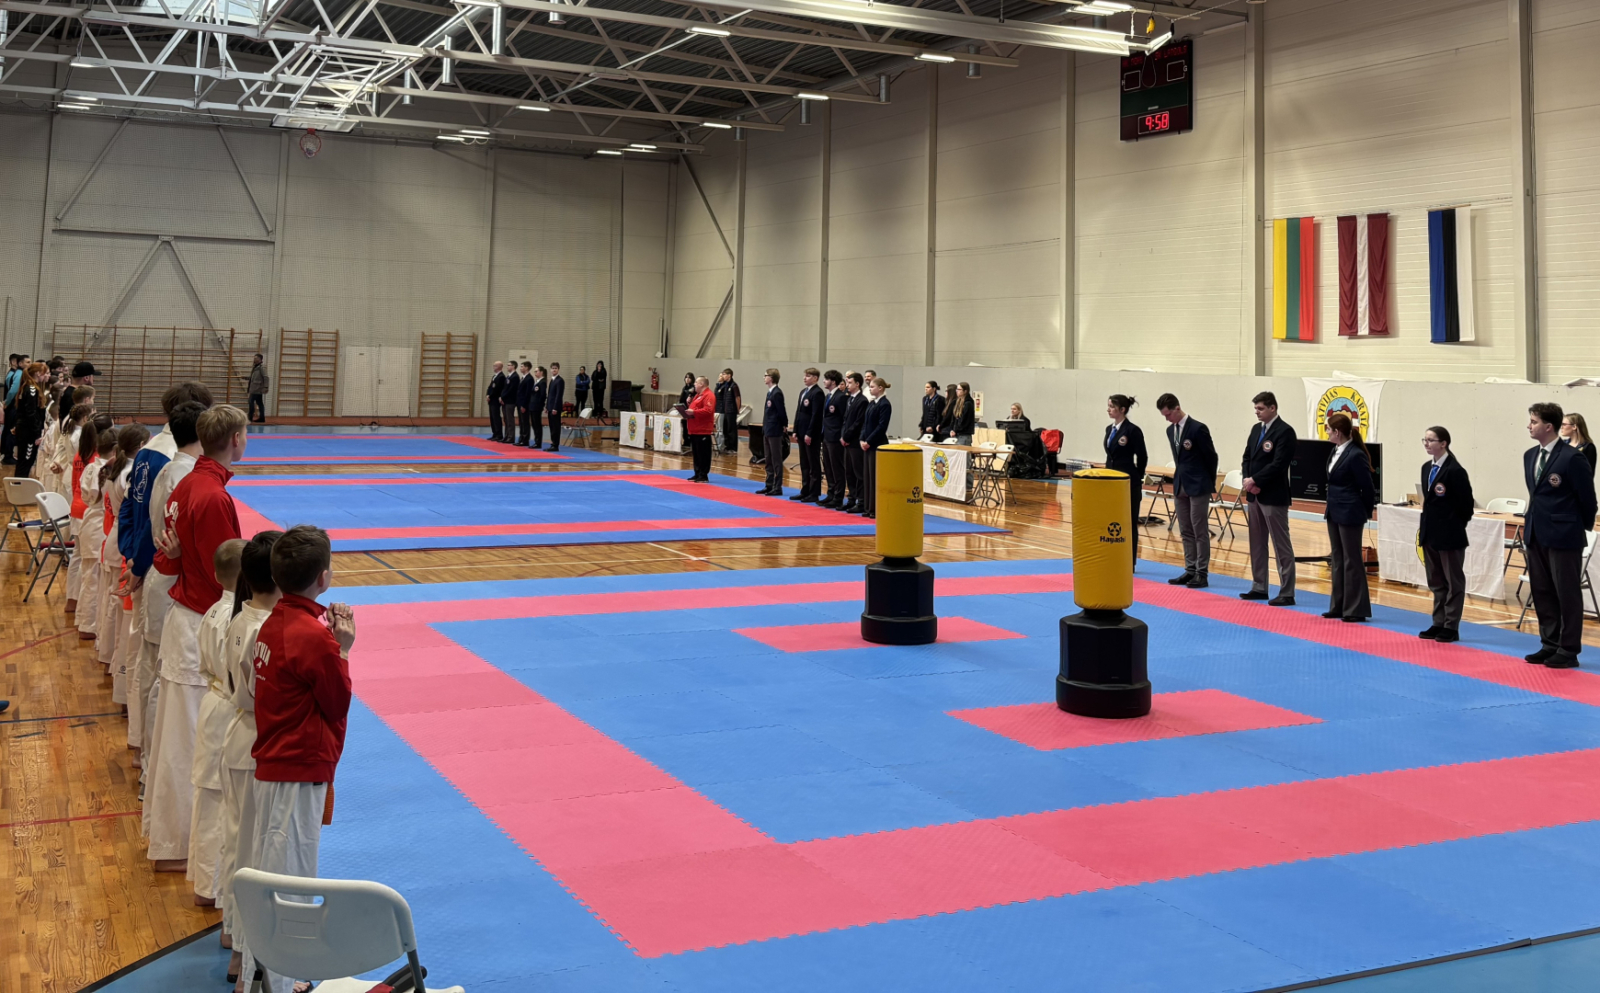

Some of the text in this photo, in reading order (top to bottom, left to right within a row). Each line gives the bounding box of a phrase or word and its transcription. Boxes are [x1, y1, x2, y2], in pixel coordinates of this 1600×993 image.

[1145, 113, 1169, 131] 9:58
[1318, 388, 1339, 426] LATVIJAS
[1099, 536, 1126, 544] Hayashi
